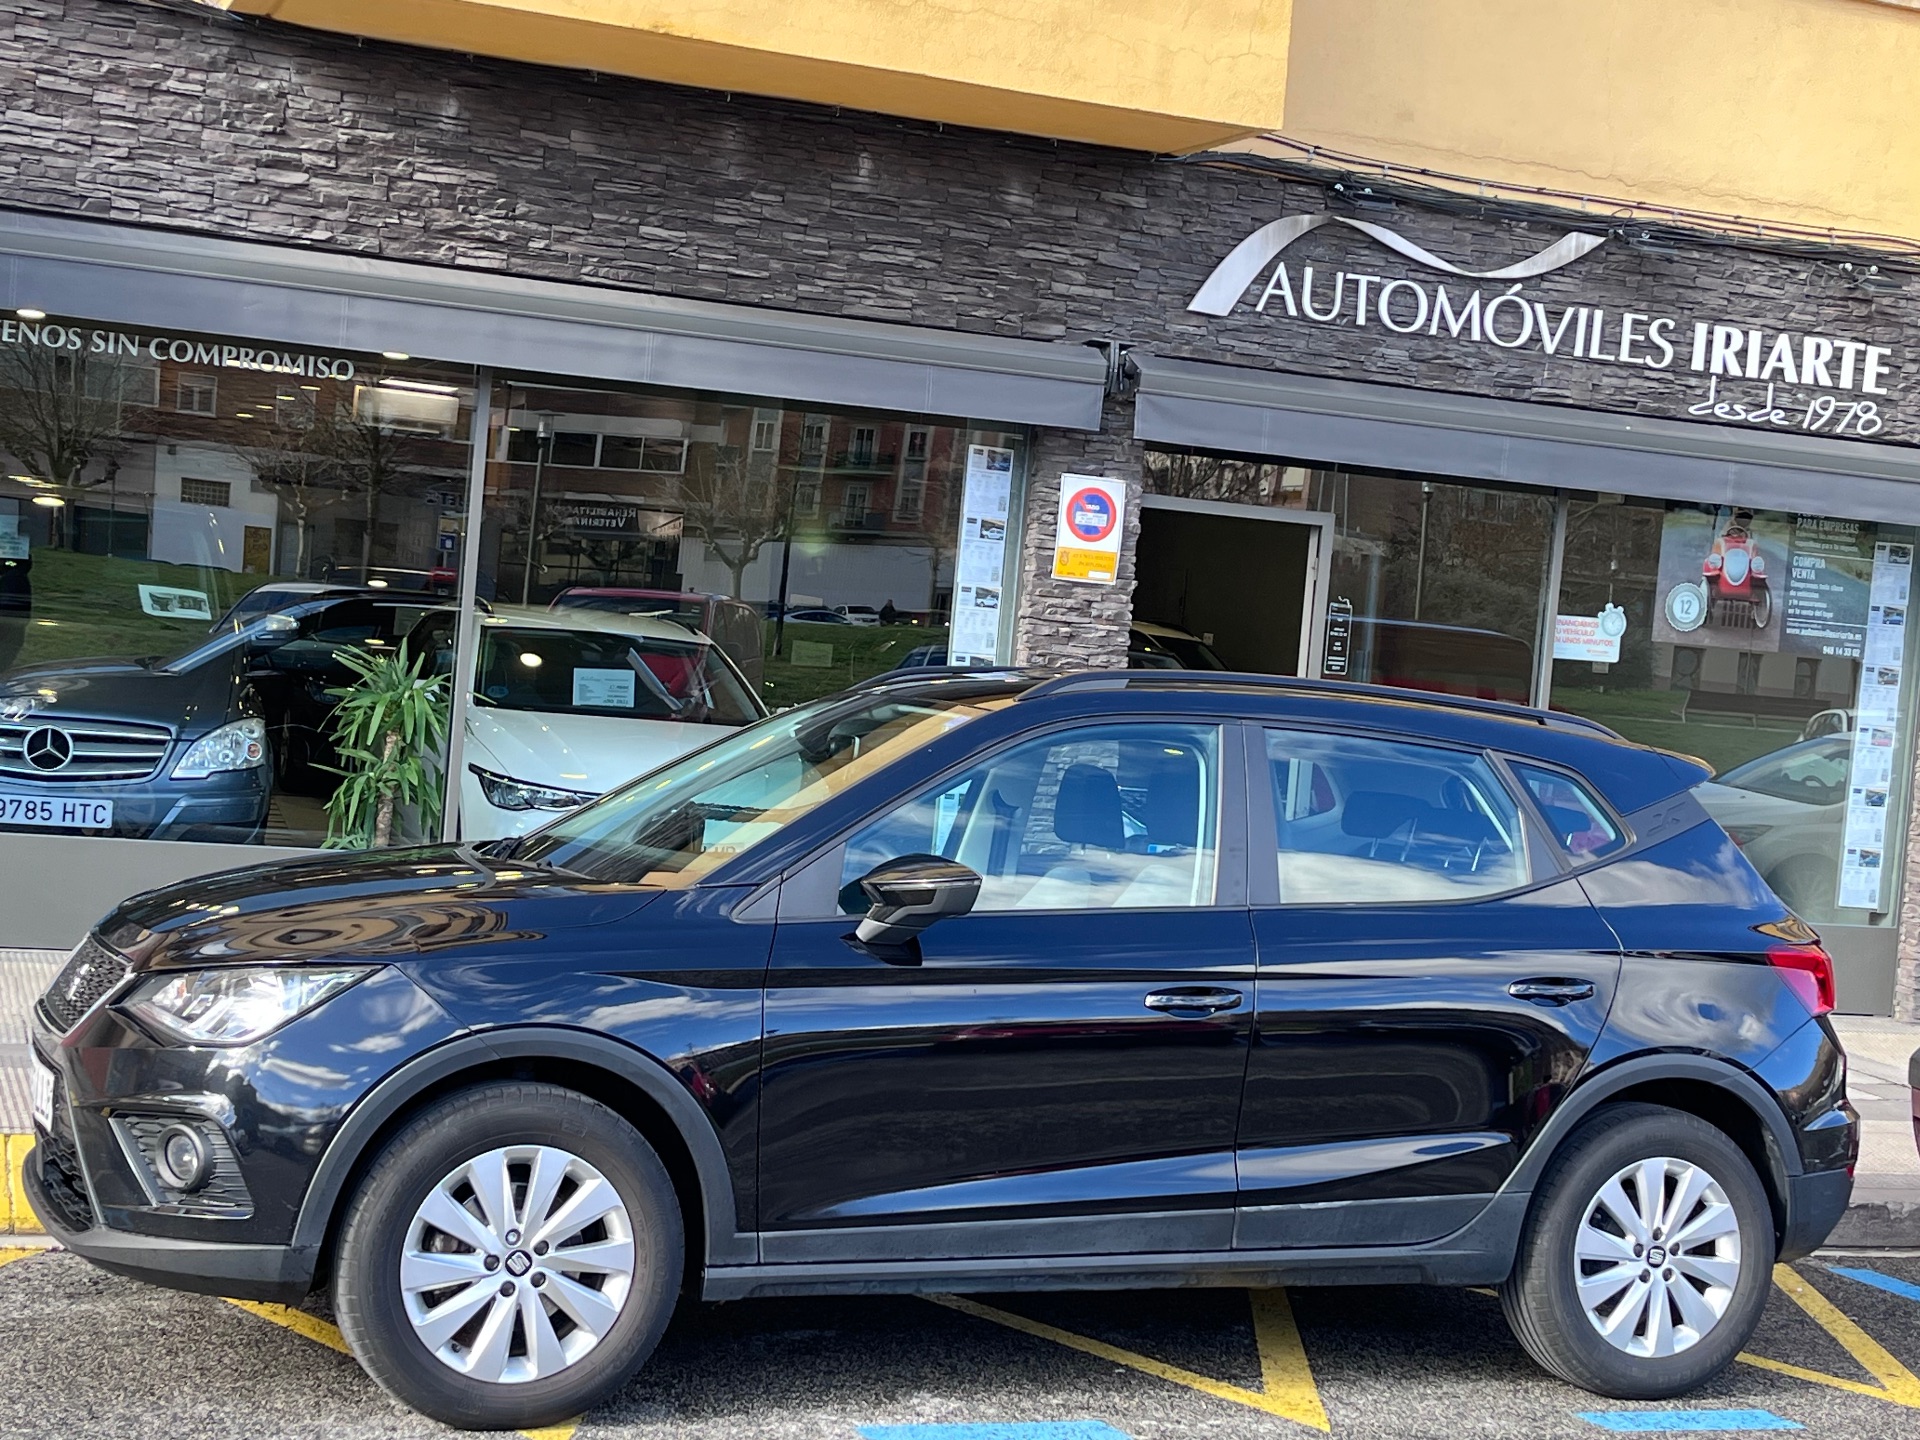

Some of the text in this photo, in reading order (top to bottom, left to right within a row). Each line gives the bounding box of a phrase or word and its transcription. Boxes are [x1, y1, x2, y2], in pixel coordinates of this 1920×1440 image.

[1255, 261, 1892, 395] AUTOMÓVILES IRIARTE
[0, 319, 355, 381] ENOS SIN COMPROMISO
[1688, 375, 1882, 435] desde 1978
[1797, 517, 1860, 534] PARA EMPRESAS
[1793, 556, 1825, 569] COMPRA
[1791, 568, 1815, 580] VENTA
[1680, 599, 1692, 615] 12
[62, 802, 107, 824] HTC
